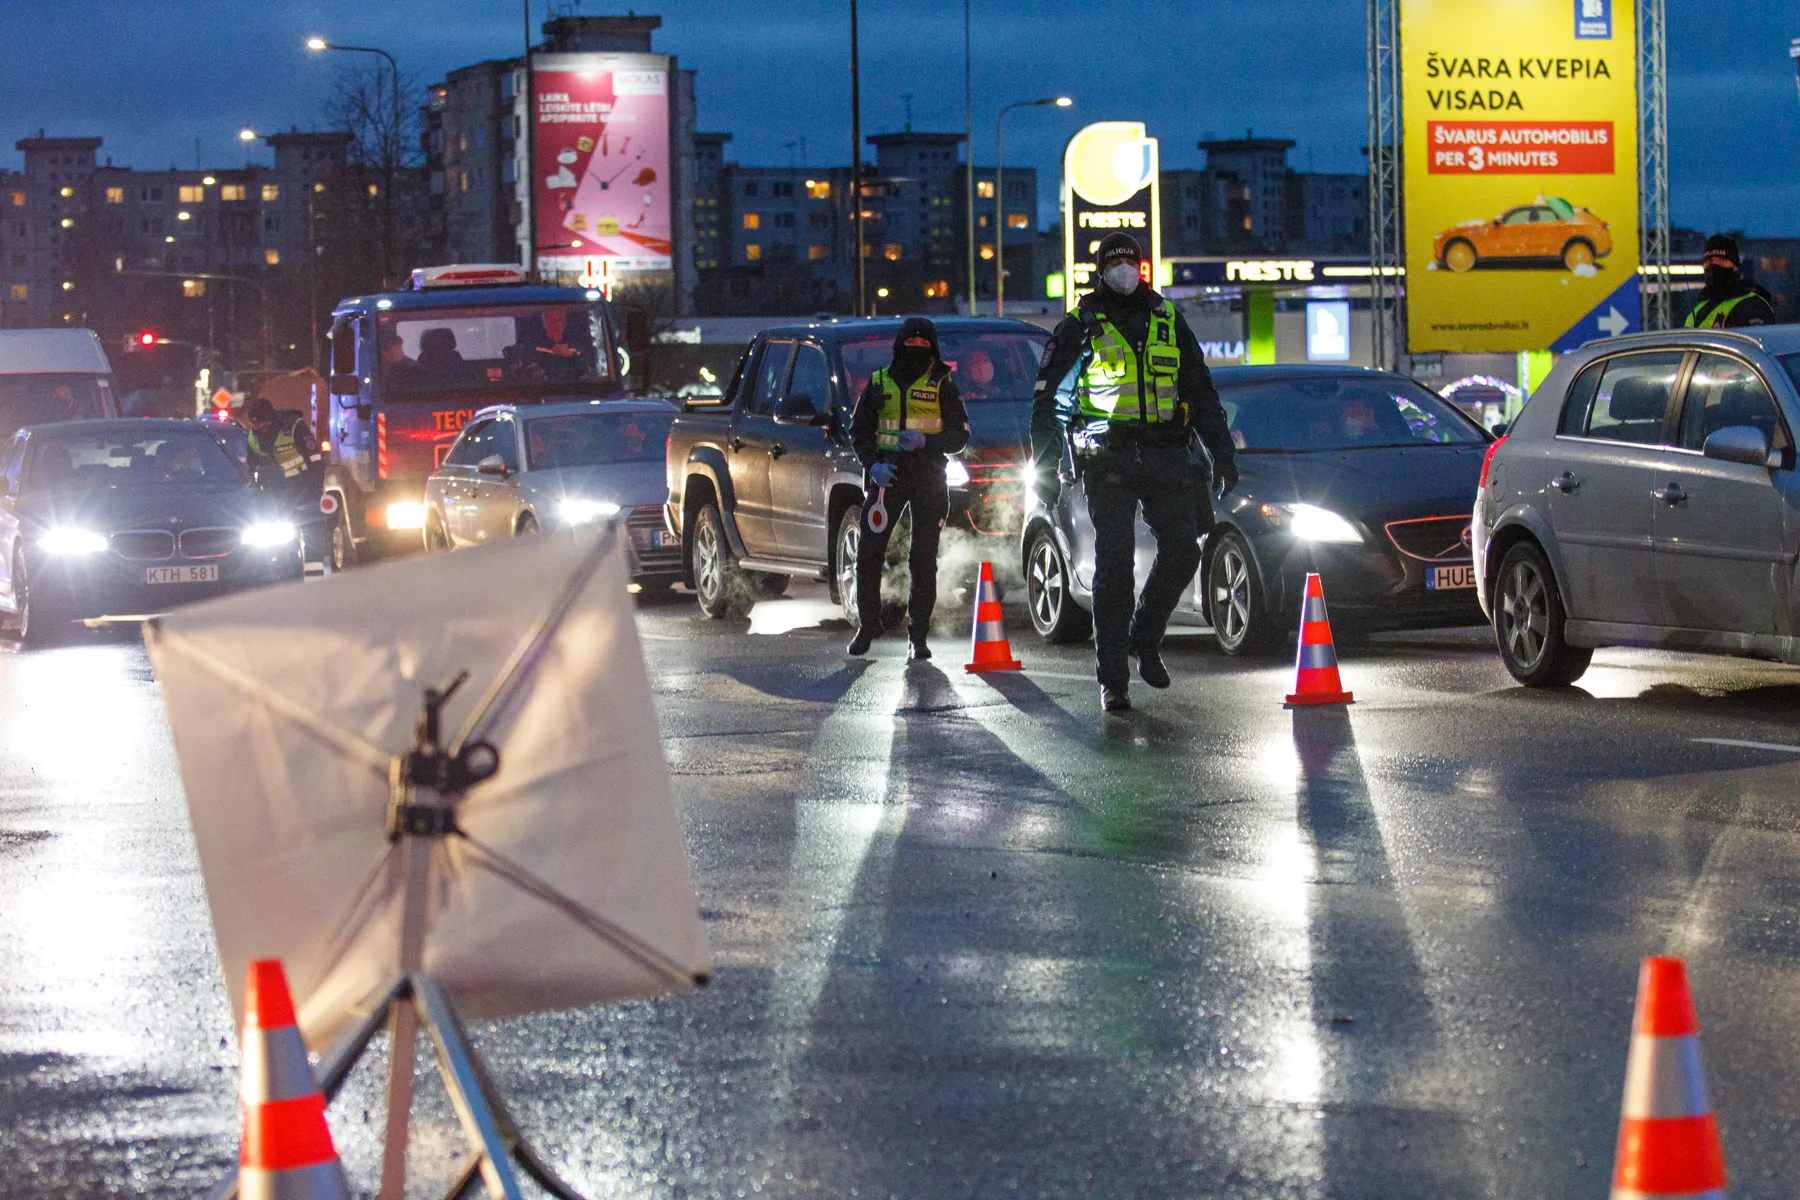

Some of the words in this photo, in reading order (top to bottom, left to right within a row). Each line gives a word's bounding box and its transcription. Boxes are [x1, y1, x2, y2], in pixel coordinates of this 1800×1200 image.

[1427, 52, 1511, 78] ŠVARA
[1519, 58, 1611, 79] KVEPIA
[1427, 89, 1524, 110] VISADA
[1434, 125, 1497, 145] ŠVARUS
[1499, 129, 1608, 145] AUTOMOBILIS
[1435, 151, 1465, 167] PER
[1468, 146, 1485, 171] 3
[1488, 151, 1559, 167] MINUTES
[1226, 261, 1315, 281] NESTE
[912, 391, 936, 400] POLICIJA
[148, 568, 181, 582] KTH
[189, 566, 216, 581] 581
[1437, 567, 1475, 587] HUE
